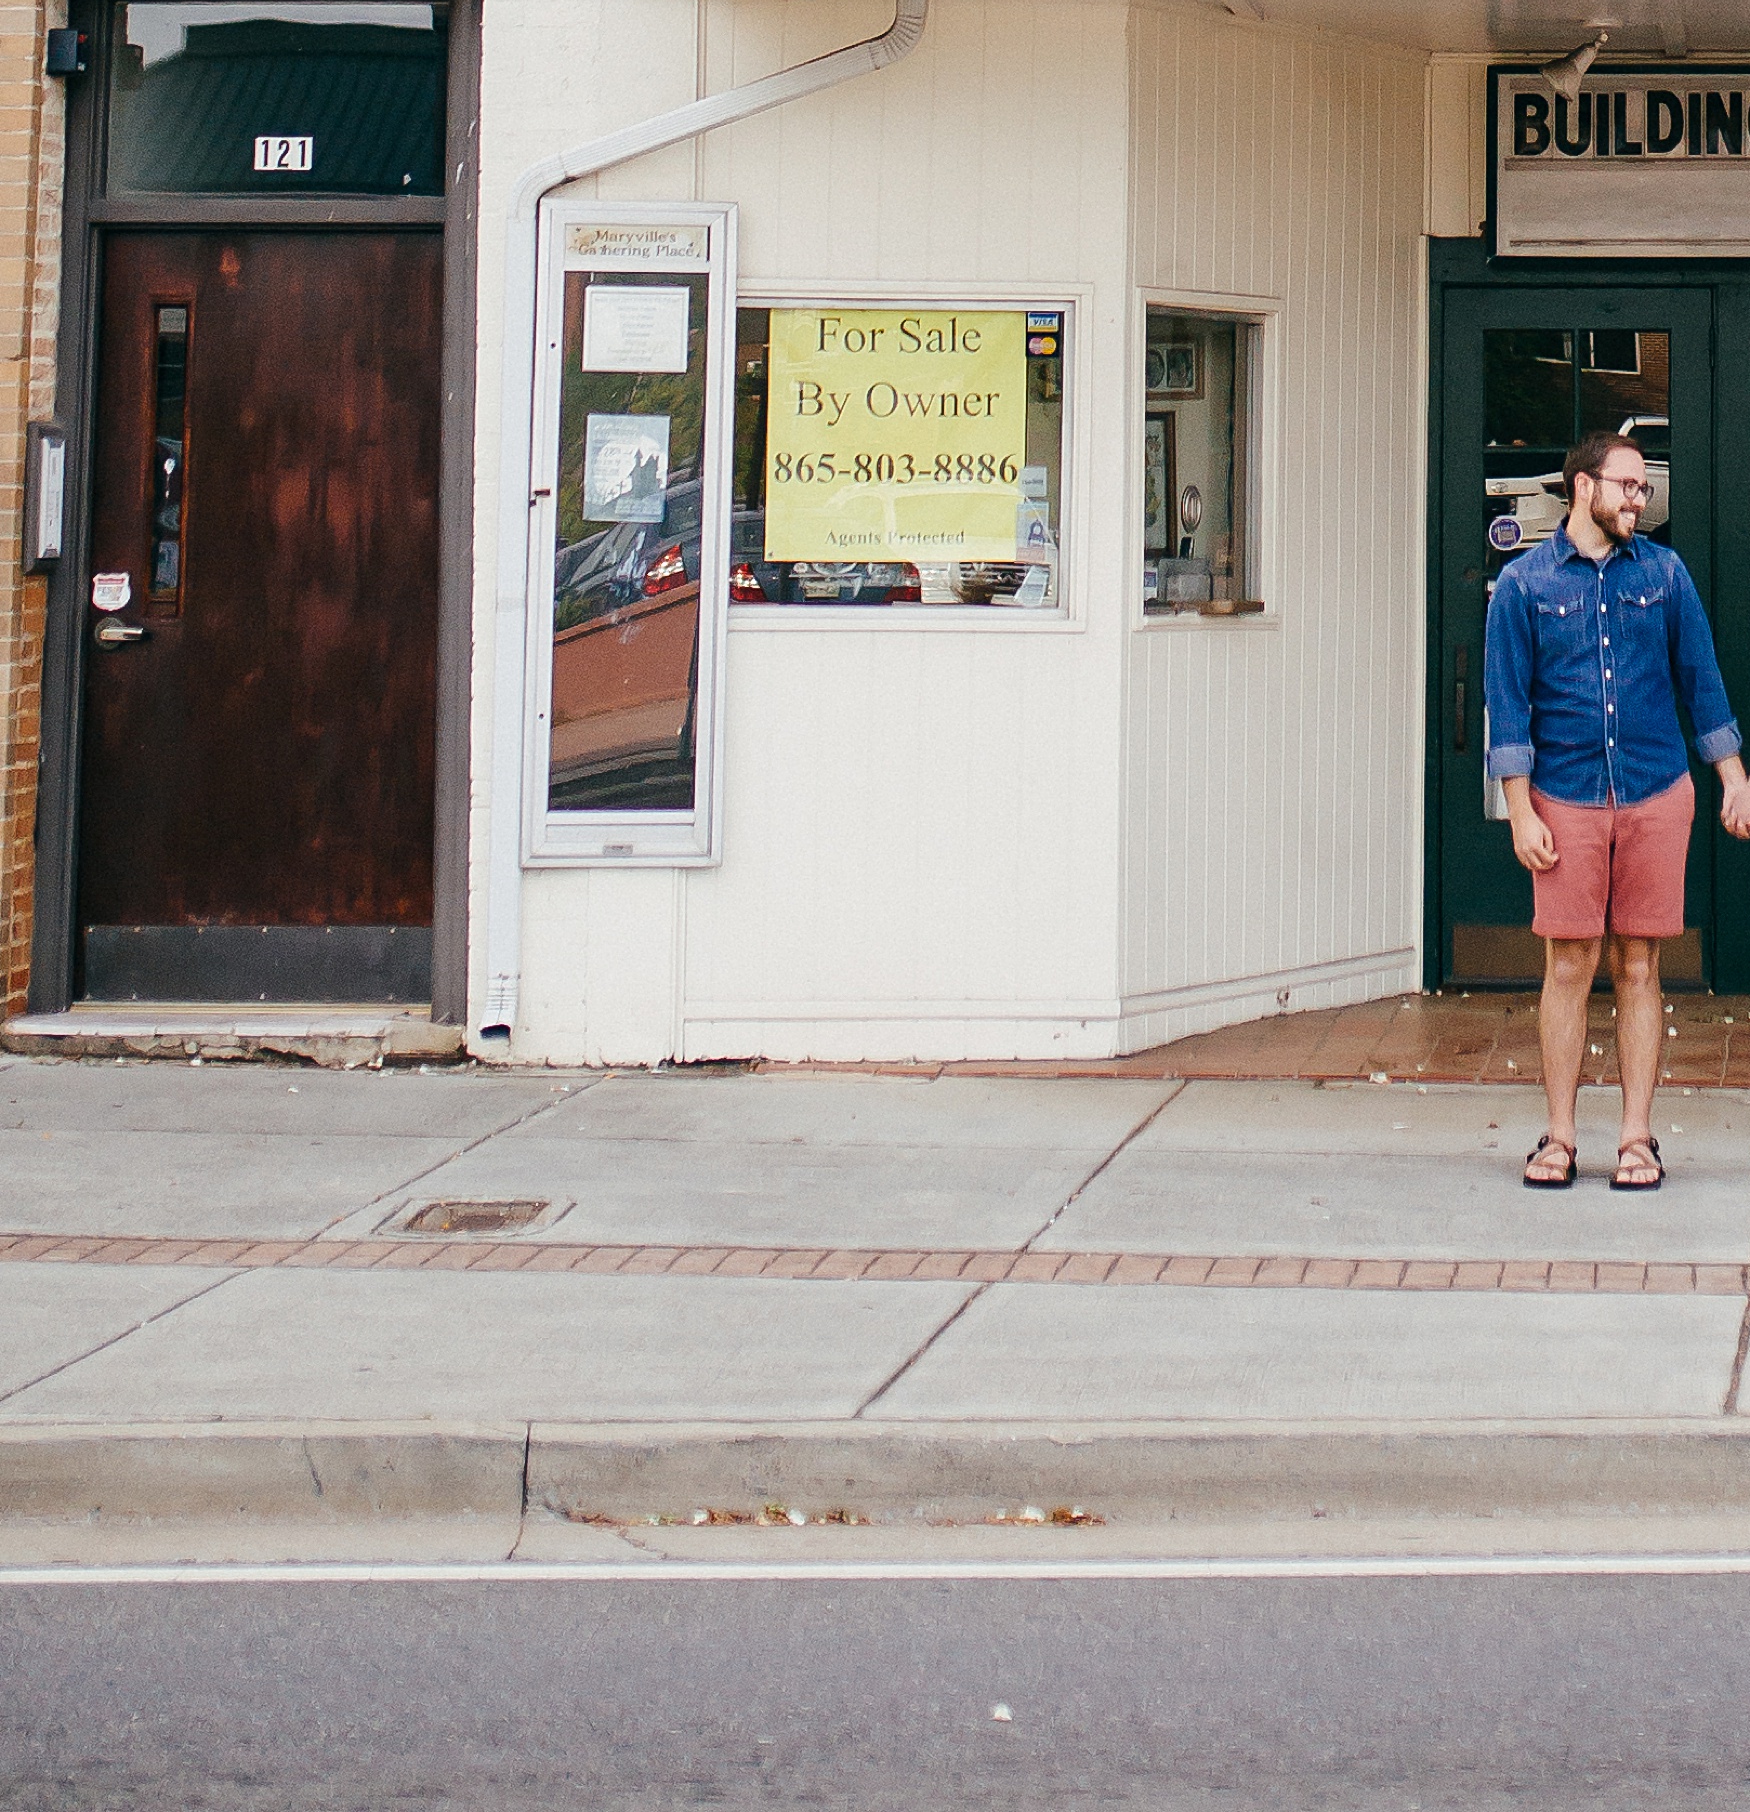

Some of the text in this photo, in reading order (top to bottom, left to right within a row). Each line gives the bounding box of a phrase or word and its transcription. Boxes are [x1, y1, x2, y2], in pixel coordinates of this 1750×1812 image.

[262, 140, 306, 167] 121
[593, 230, 676, 243] Maryville's
[817, 317, 982, 353] For Sale
[797, 380, 1000, 426] By Owner
[773, 452, 1018, 484] 865-803-8886
[825, 531, 965, 548] Agents Protected
